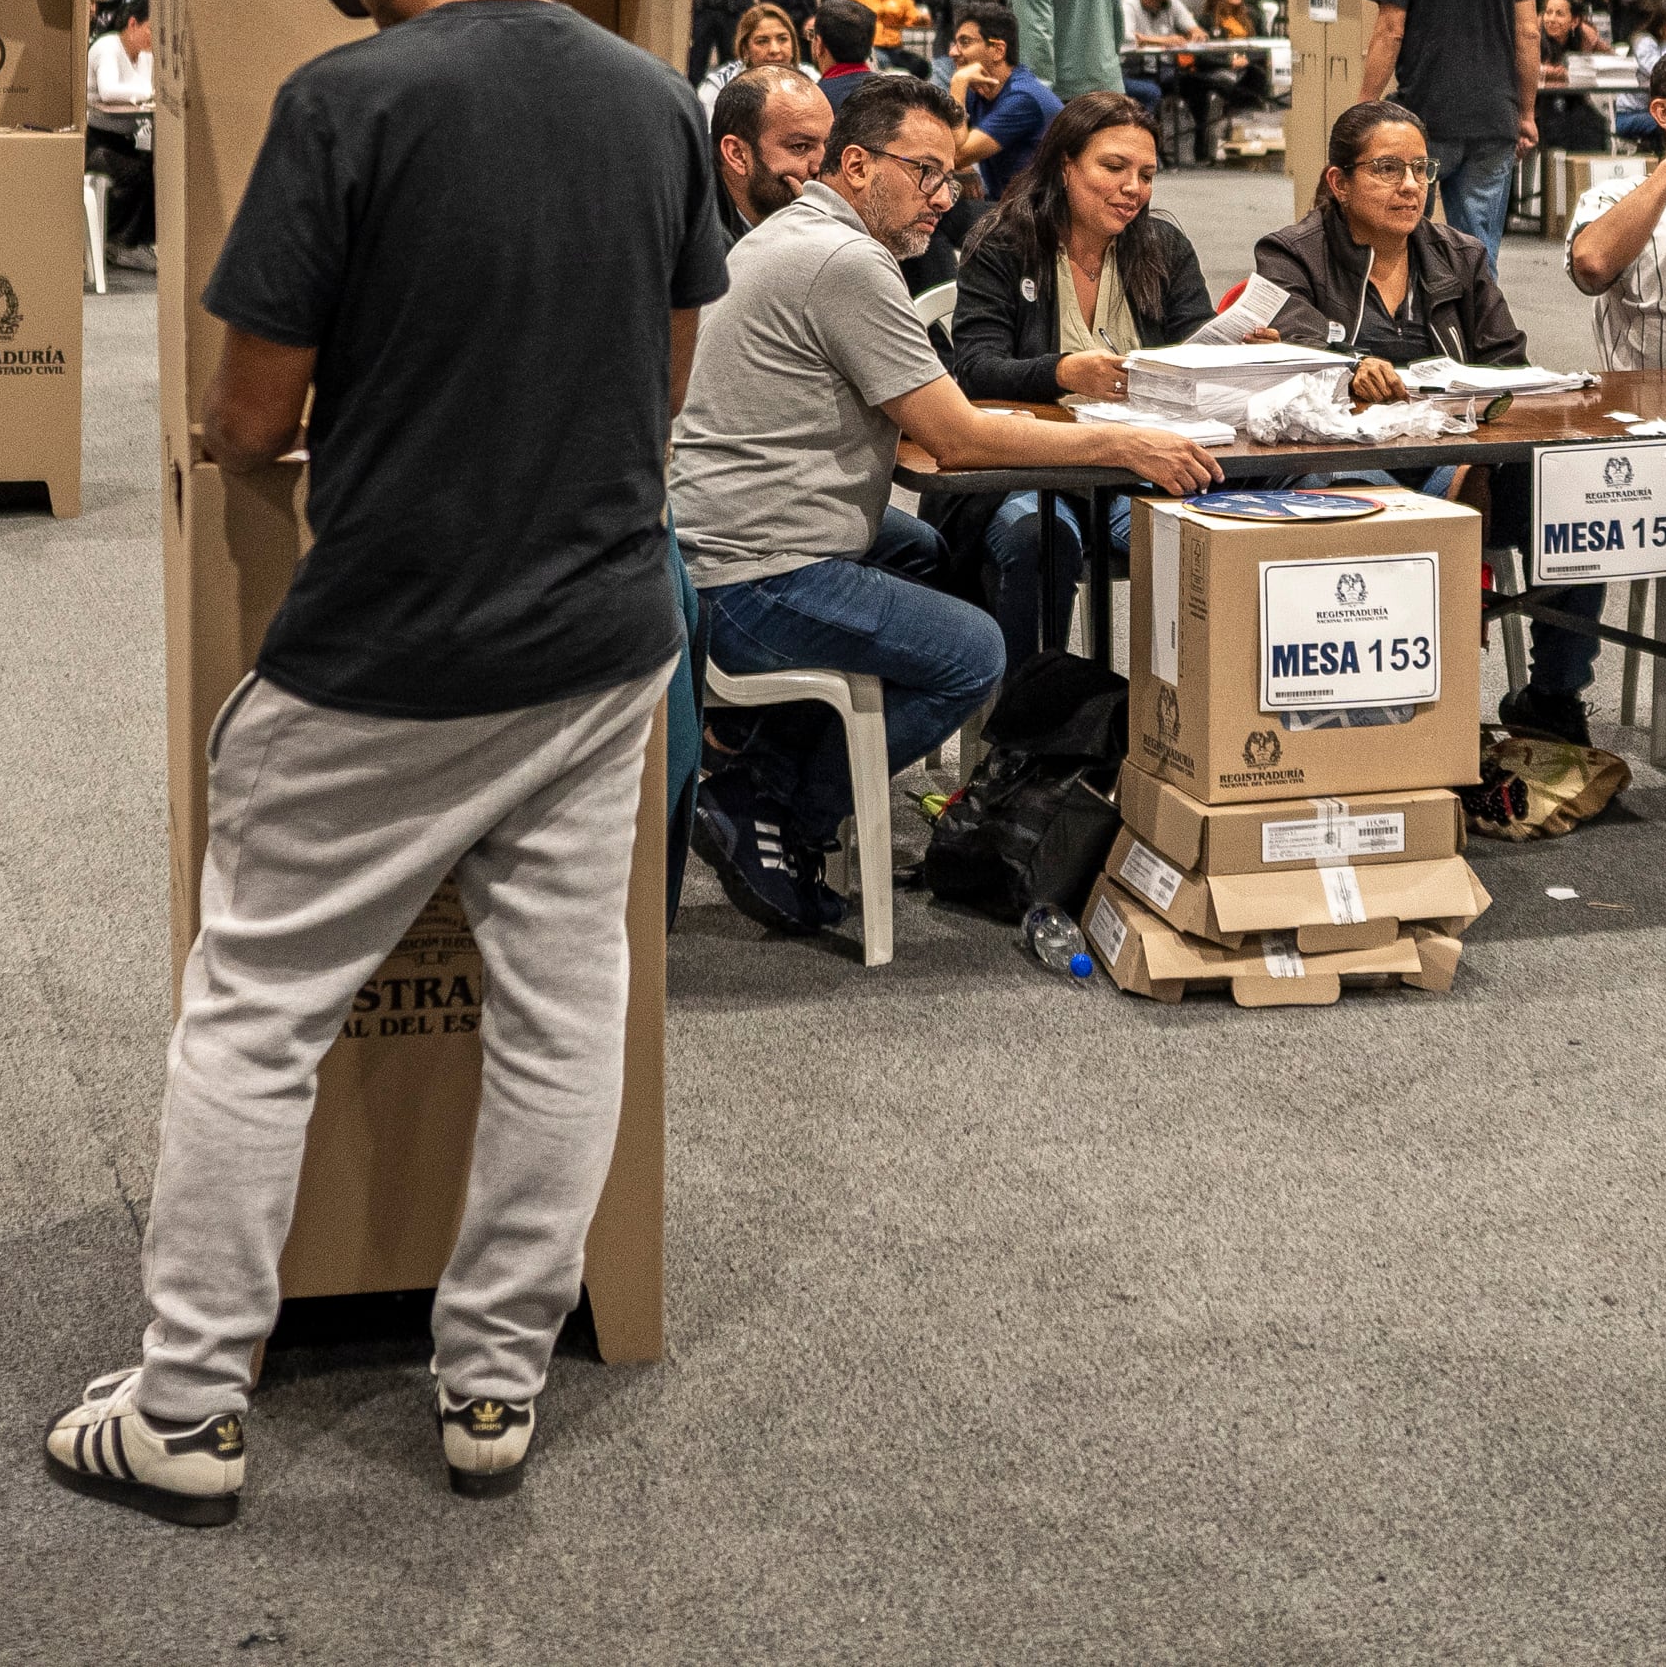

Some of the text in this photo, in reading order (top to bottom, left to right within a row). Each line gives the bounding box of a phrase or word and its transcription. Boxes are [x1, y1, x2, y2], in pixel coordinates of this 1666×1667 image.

[36, 365, 65, 375] CIVIL
[1585, 488, 1652, 500] REGISTRADURÍA
[1544, 519, 1625, 555] MESA
[1316, 606, 1388, 619] REGISTRADURÍA
[1272, 636, 1431, 678] MESA 153
[1219, 767, 1305, 783] REGISTRADURÍA
[380, 1016, 433, 1036] DEL
